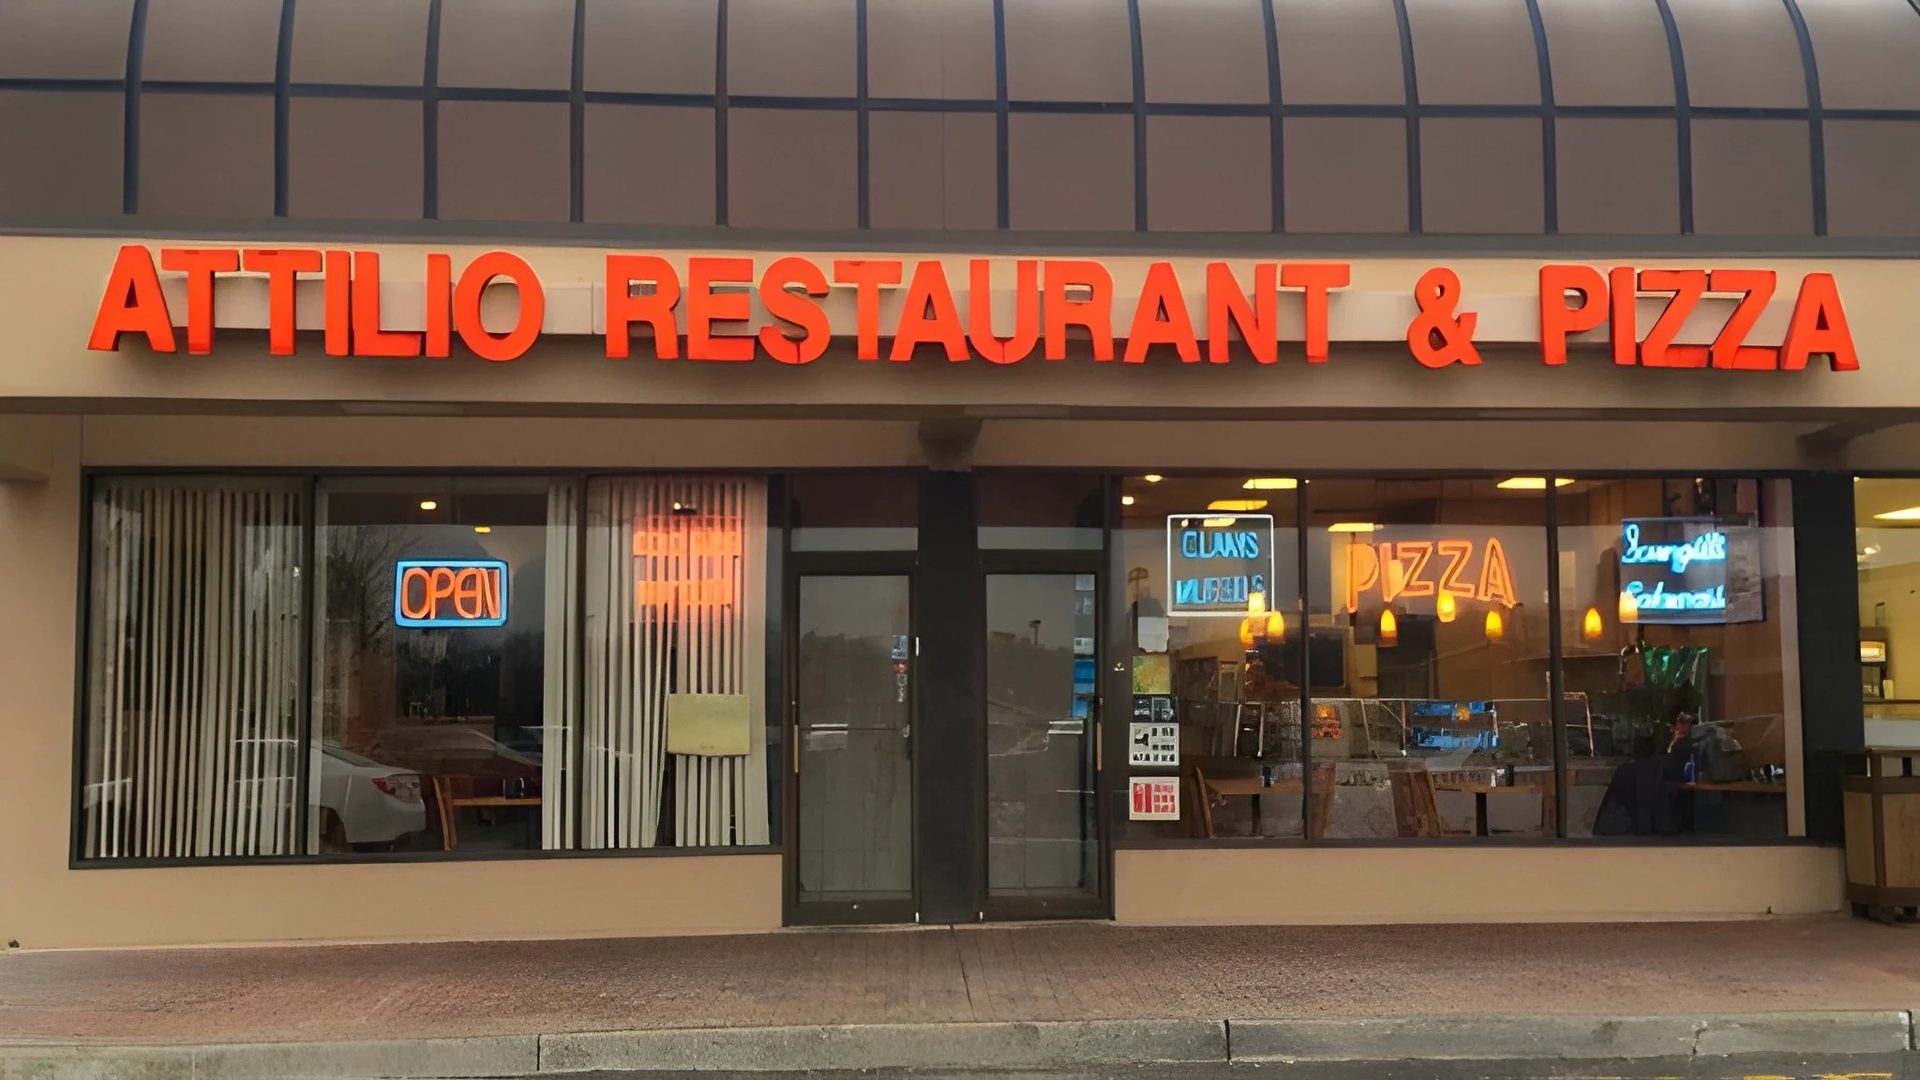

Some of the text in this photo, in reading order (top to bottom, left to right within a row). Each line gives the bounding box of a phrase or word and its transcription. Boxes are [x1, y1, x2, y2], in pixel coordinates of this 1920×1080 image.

[87, 245, 1860, 372] ATTILIO RESTAURANT & PIZZA
[401, 567, 501, 619] OPEN
[1346, 537, 1518, 613] PIZZA
